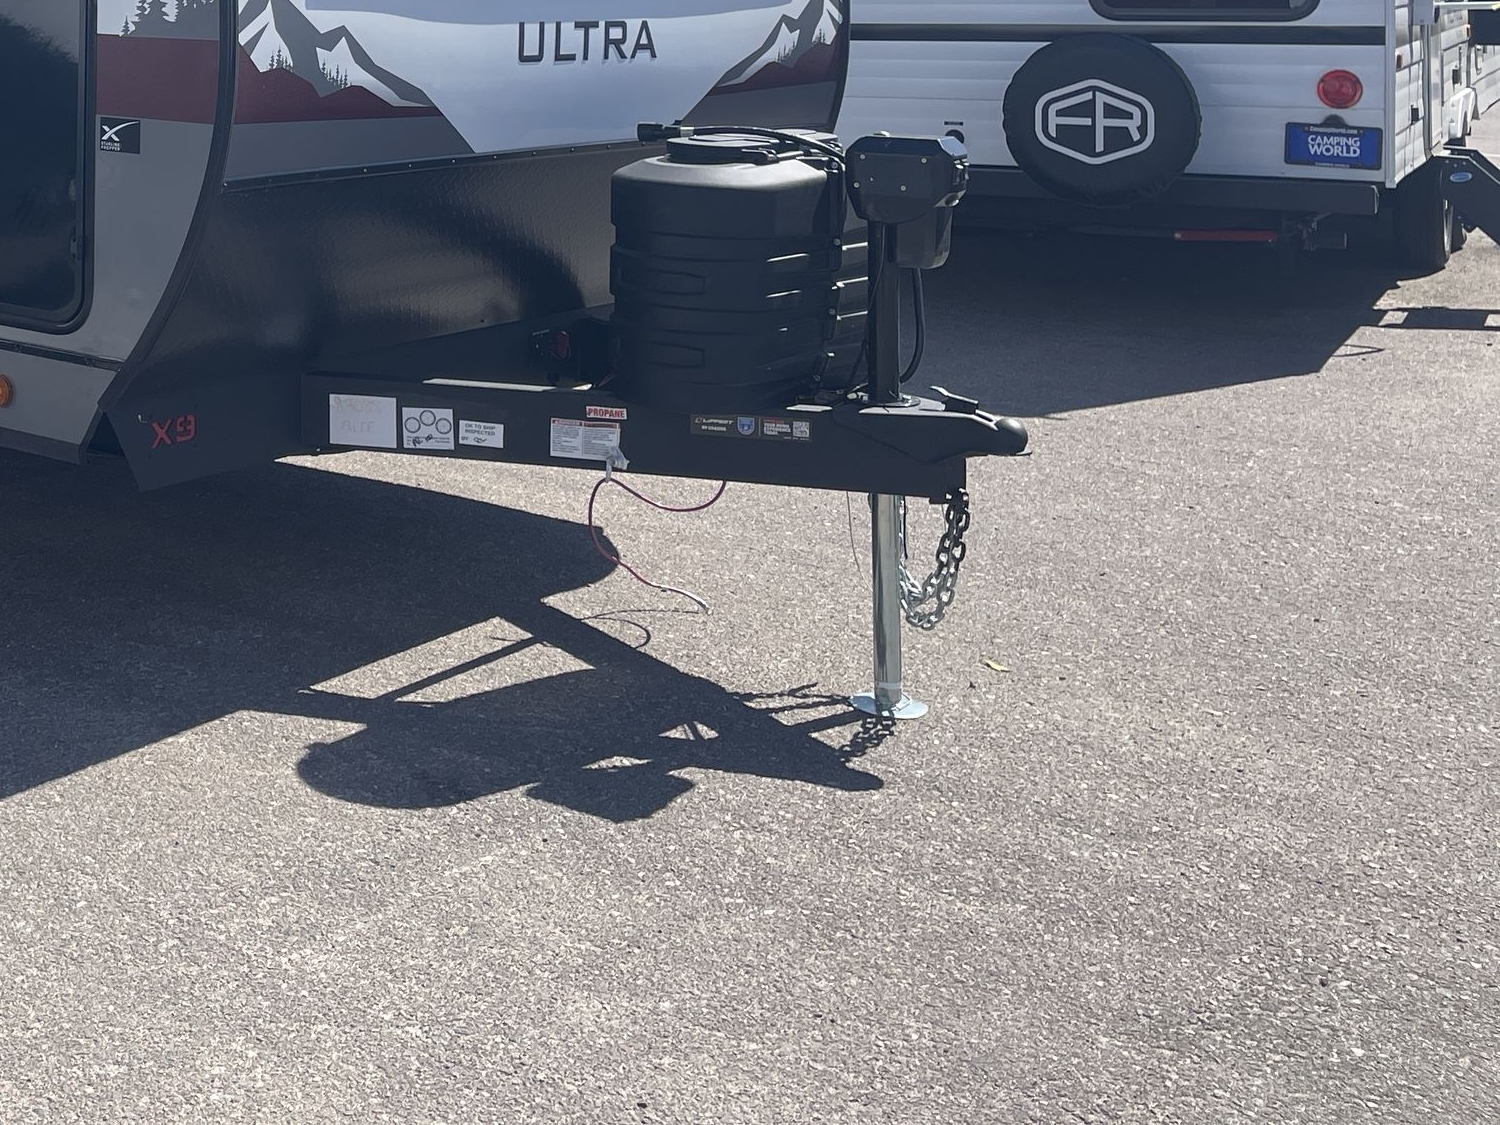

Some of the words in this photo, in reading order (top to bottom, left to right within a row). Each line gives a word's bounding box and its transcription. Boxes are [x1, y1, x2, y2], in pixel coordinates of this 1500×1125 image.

[517, 20, 658, 64] ULTRA
[1307, 134, 1361, 148] CAMPING
[1307, 143, 1361, 158] WORLD
[587, 407, 626, 419] PROPANE
